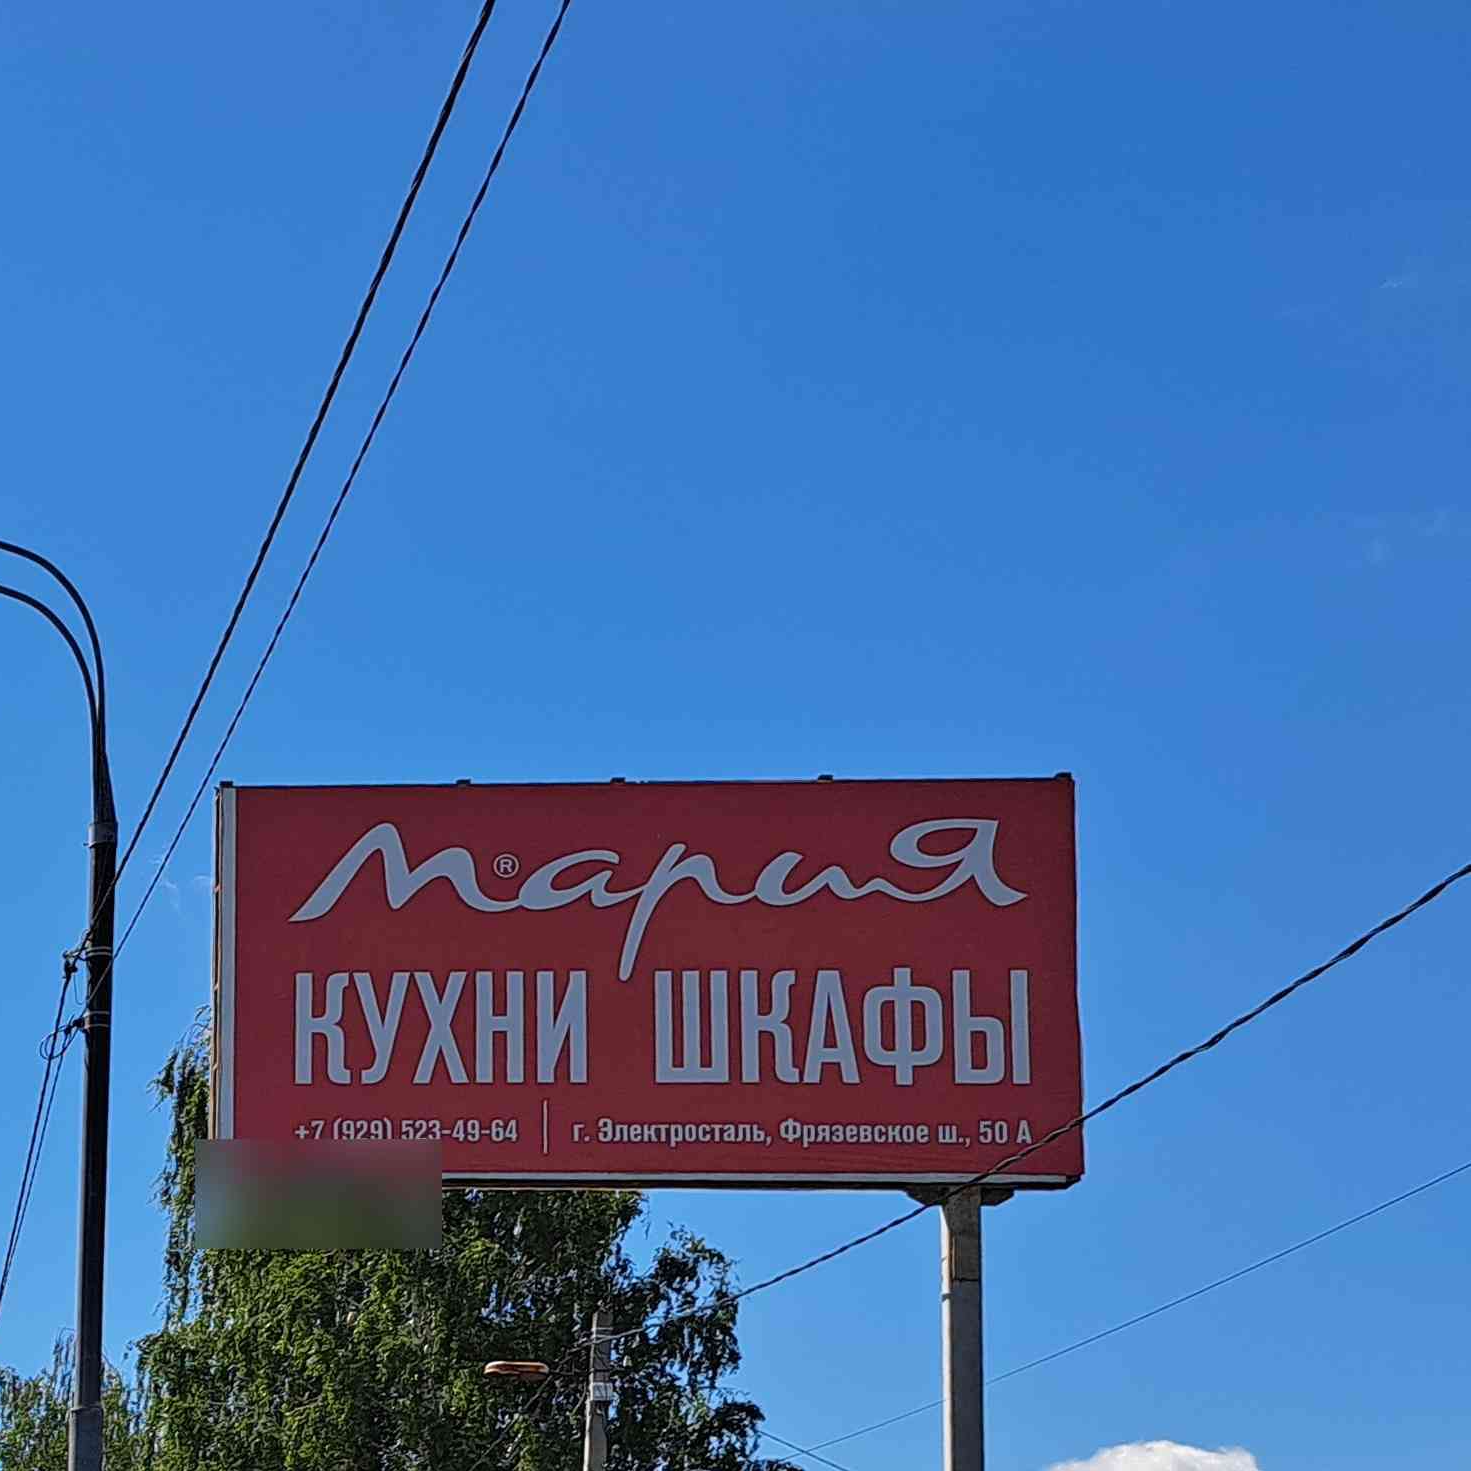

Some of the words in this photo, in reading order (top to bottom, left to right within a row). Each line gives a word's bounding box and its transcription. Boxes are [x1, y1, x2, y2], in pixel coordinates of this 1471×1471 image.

[287, 817, 1029, 982] Мария
[294, 969, 589, 1086] КУХНИ
[655, 968, 1031, 1086] ШКАФЫ
[294, 1119, 325, 1141] +7
[333, 1116, 392, 1141] (929)
[402, 1118, 519, 1143] 523-49-64
[572, 1121, 590, 1143] г.
[598, 1117, 772, 1149] Электросталь,
[779, 1117, 930, 1149] Фрязевское
[978, 1120, 1008, 1144] 50
[1015, 1120, 1033, 1144] А
